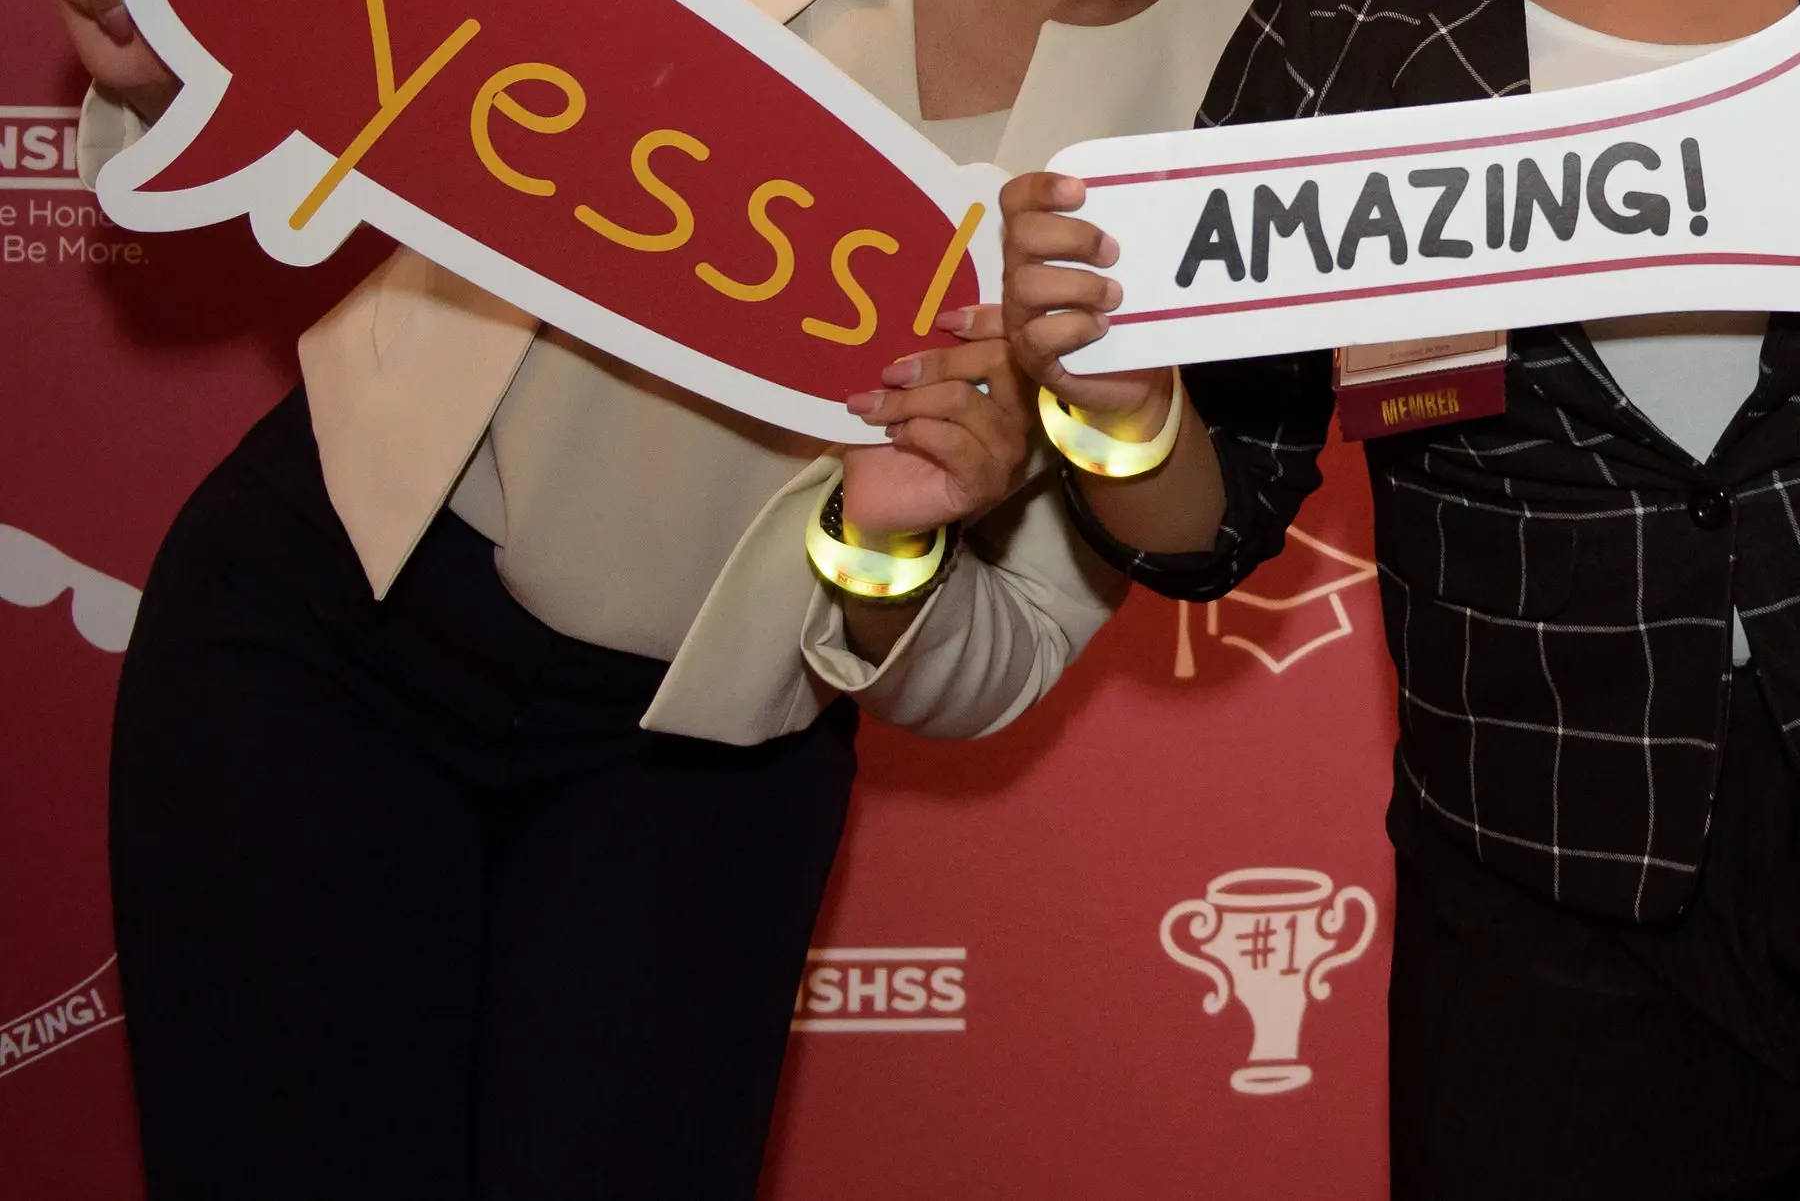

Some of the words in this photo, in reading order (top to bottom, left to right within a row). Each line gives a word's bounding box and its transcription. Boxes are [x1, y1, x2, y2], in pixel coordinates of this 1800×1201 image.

[1175, 137, 1709, 288] AMAZING!
[4, 235, 46, 262] Be
[59, 236, 149, 264] More.
[1381, 387, 1460, 426] MEMBER
[1235, 915, 1301, 976] #1
[796, 967, 967, 1013] SHSS
[0, 988, 106, 1066] AZING!
